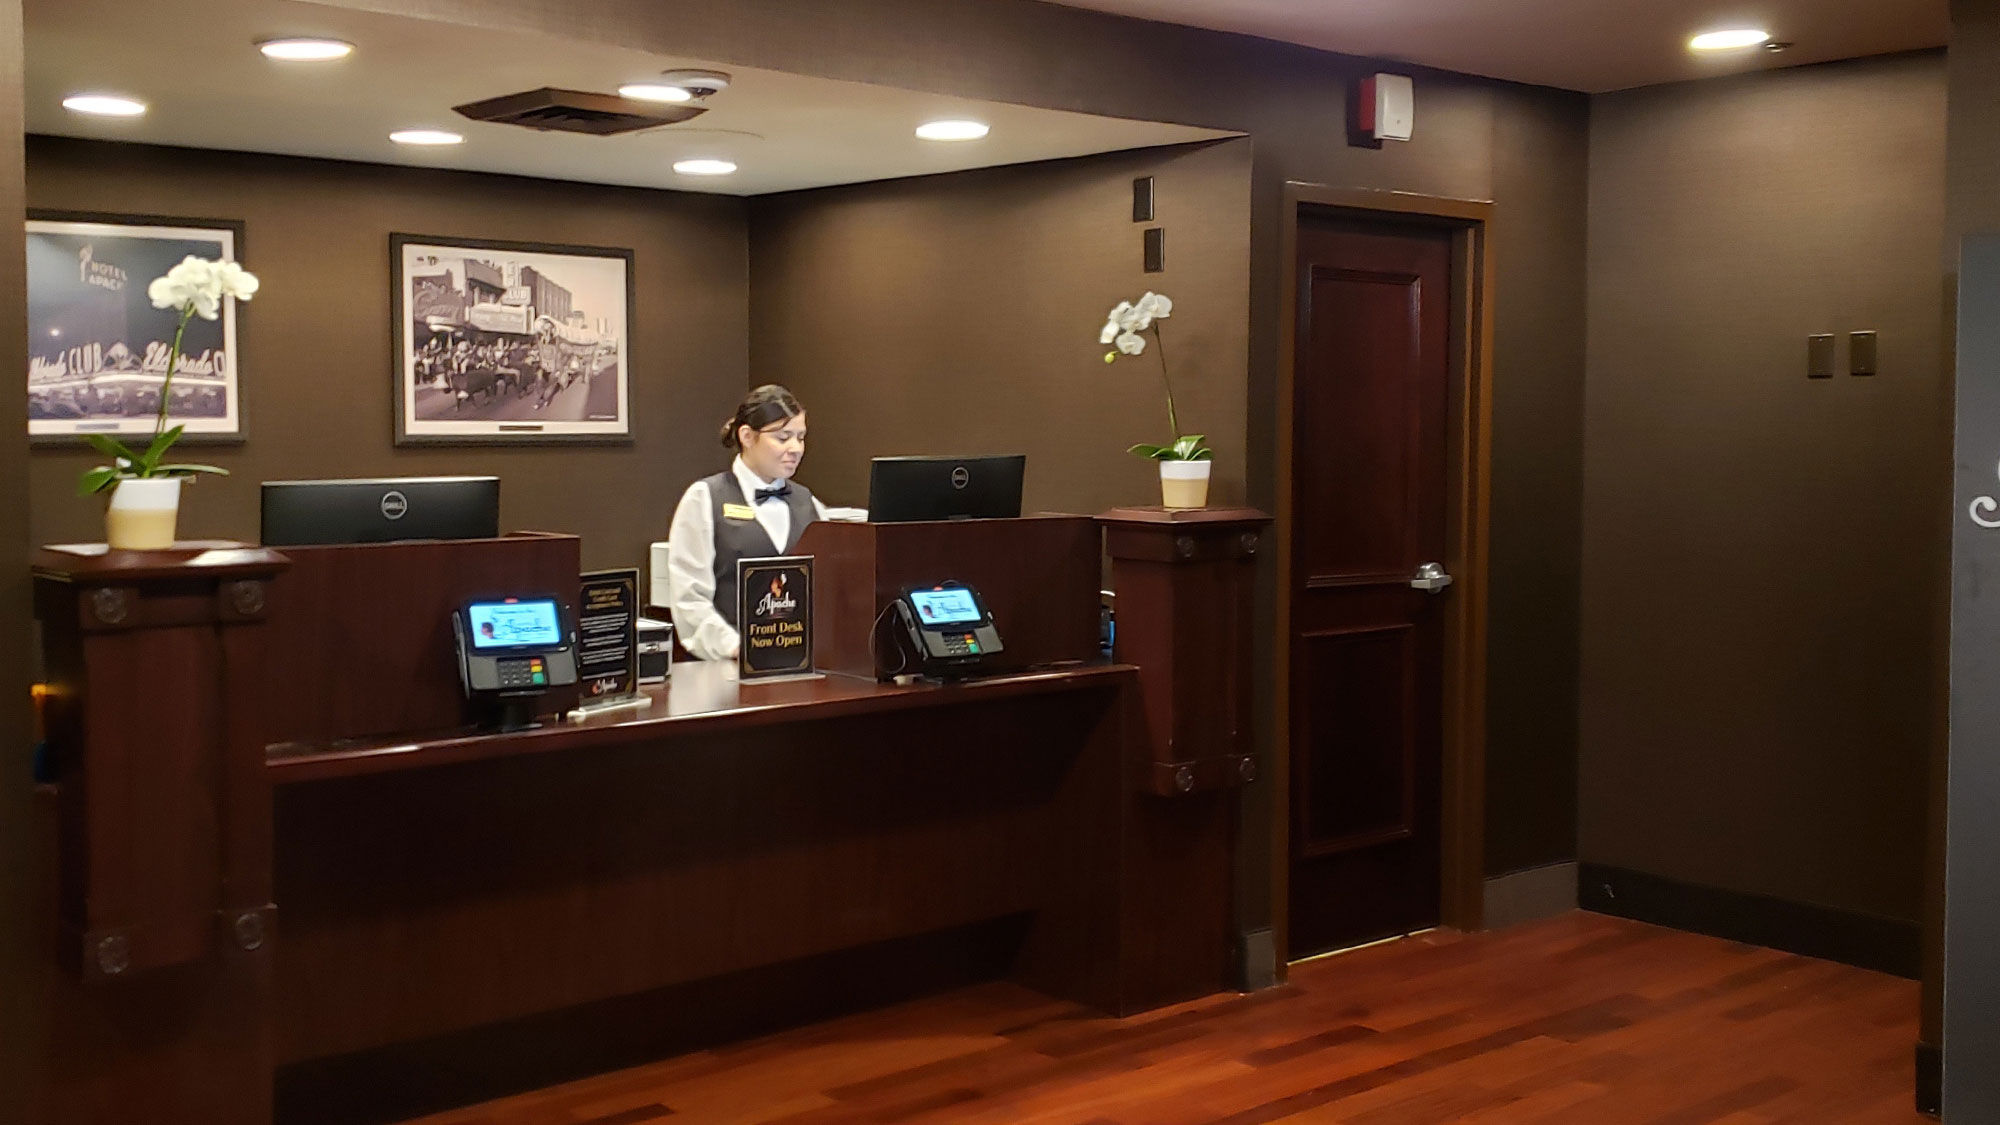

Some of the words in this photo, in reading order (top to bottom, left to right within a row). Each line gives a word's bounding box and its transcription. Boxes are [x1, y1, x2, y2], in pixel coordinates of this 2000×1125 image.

[755, 591, 797, 616] Apache
[749, 622, 777, 636] Front
[780, 621, 804, 634] Desk
[751, 637, 774, 649] Now
[776, 634, 802, 649] Open
